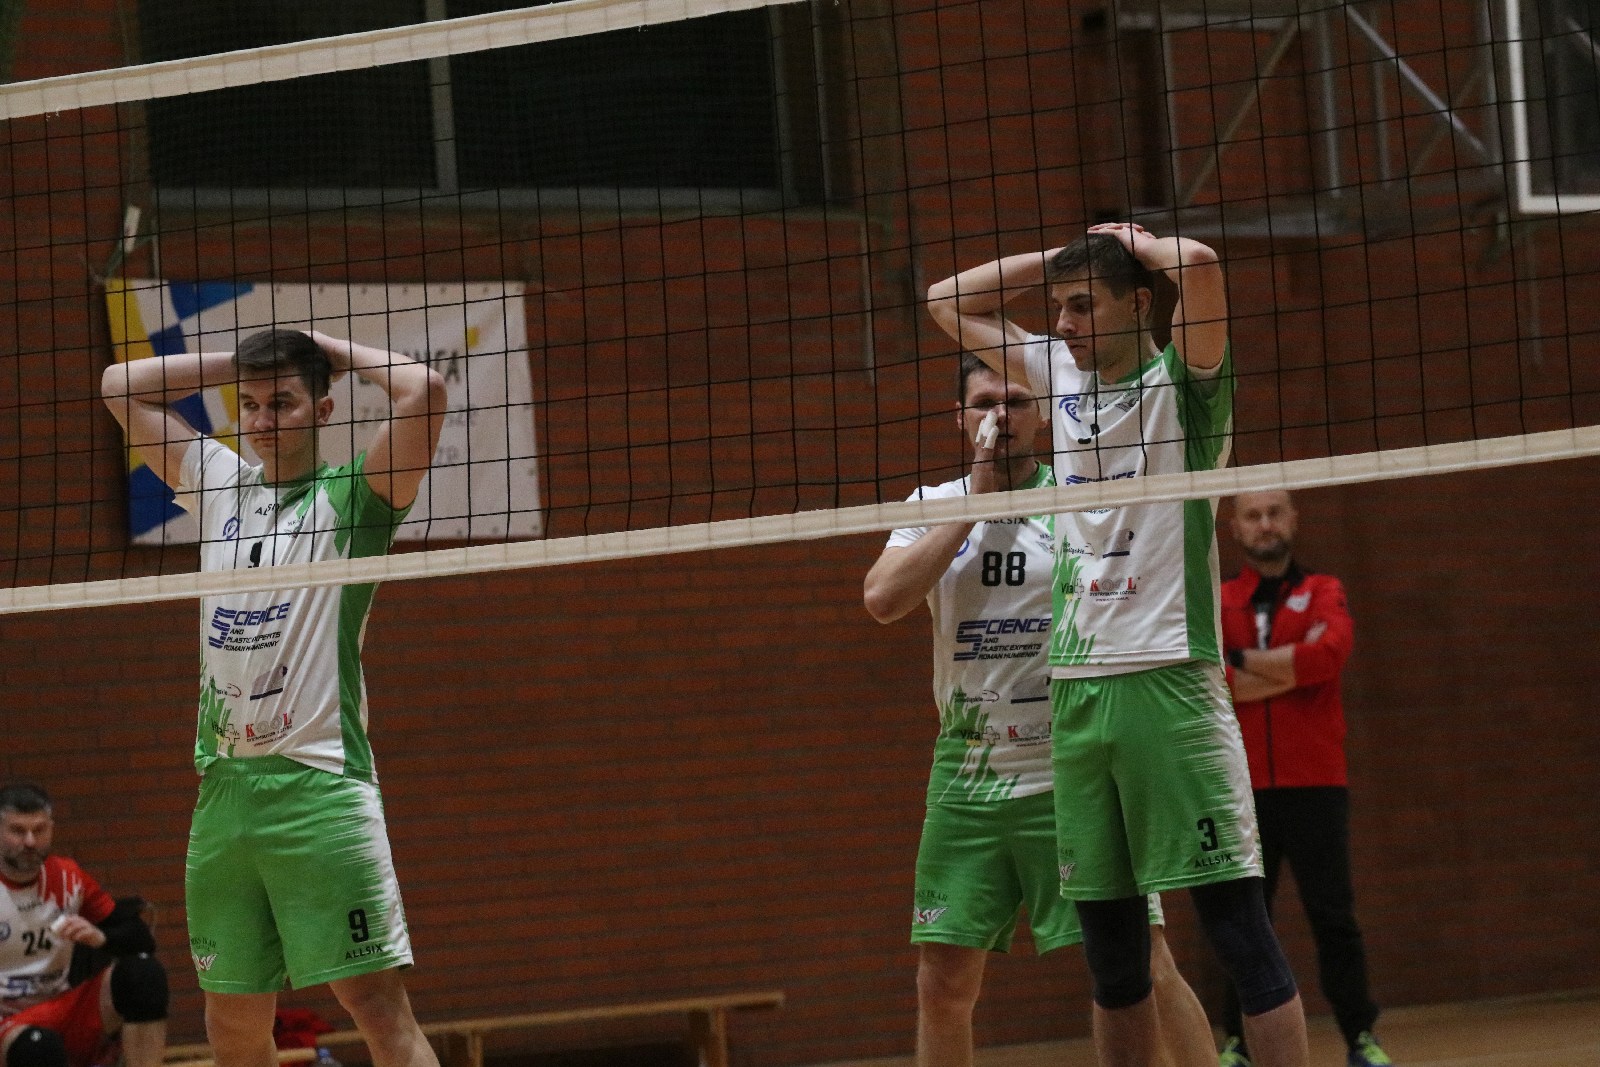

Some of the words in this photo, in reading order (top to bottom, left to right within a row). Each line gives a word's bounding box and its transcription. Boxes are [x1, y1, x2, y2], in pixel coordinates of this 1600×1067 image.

[982, 551, 1026, 587] 88
[208, 602, 291, 649] SCIENCE
[953, 618, 1052, 661] SCIENCE
[981, 644, 1009, 652] PLASTIC
[1009, 642, 1042, 651] EXPERTS
[1197, 817, 1219, 852] 3
[1194, 853, 1233, 868] ALLSIX
[22, 926, 54, 957] 24
[348, 908, 370, 943] 9
[345, 943, 383, 960] ALLSIX
